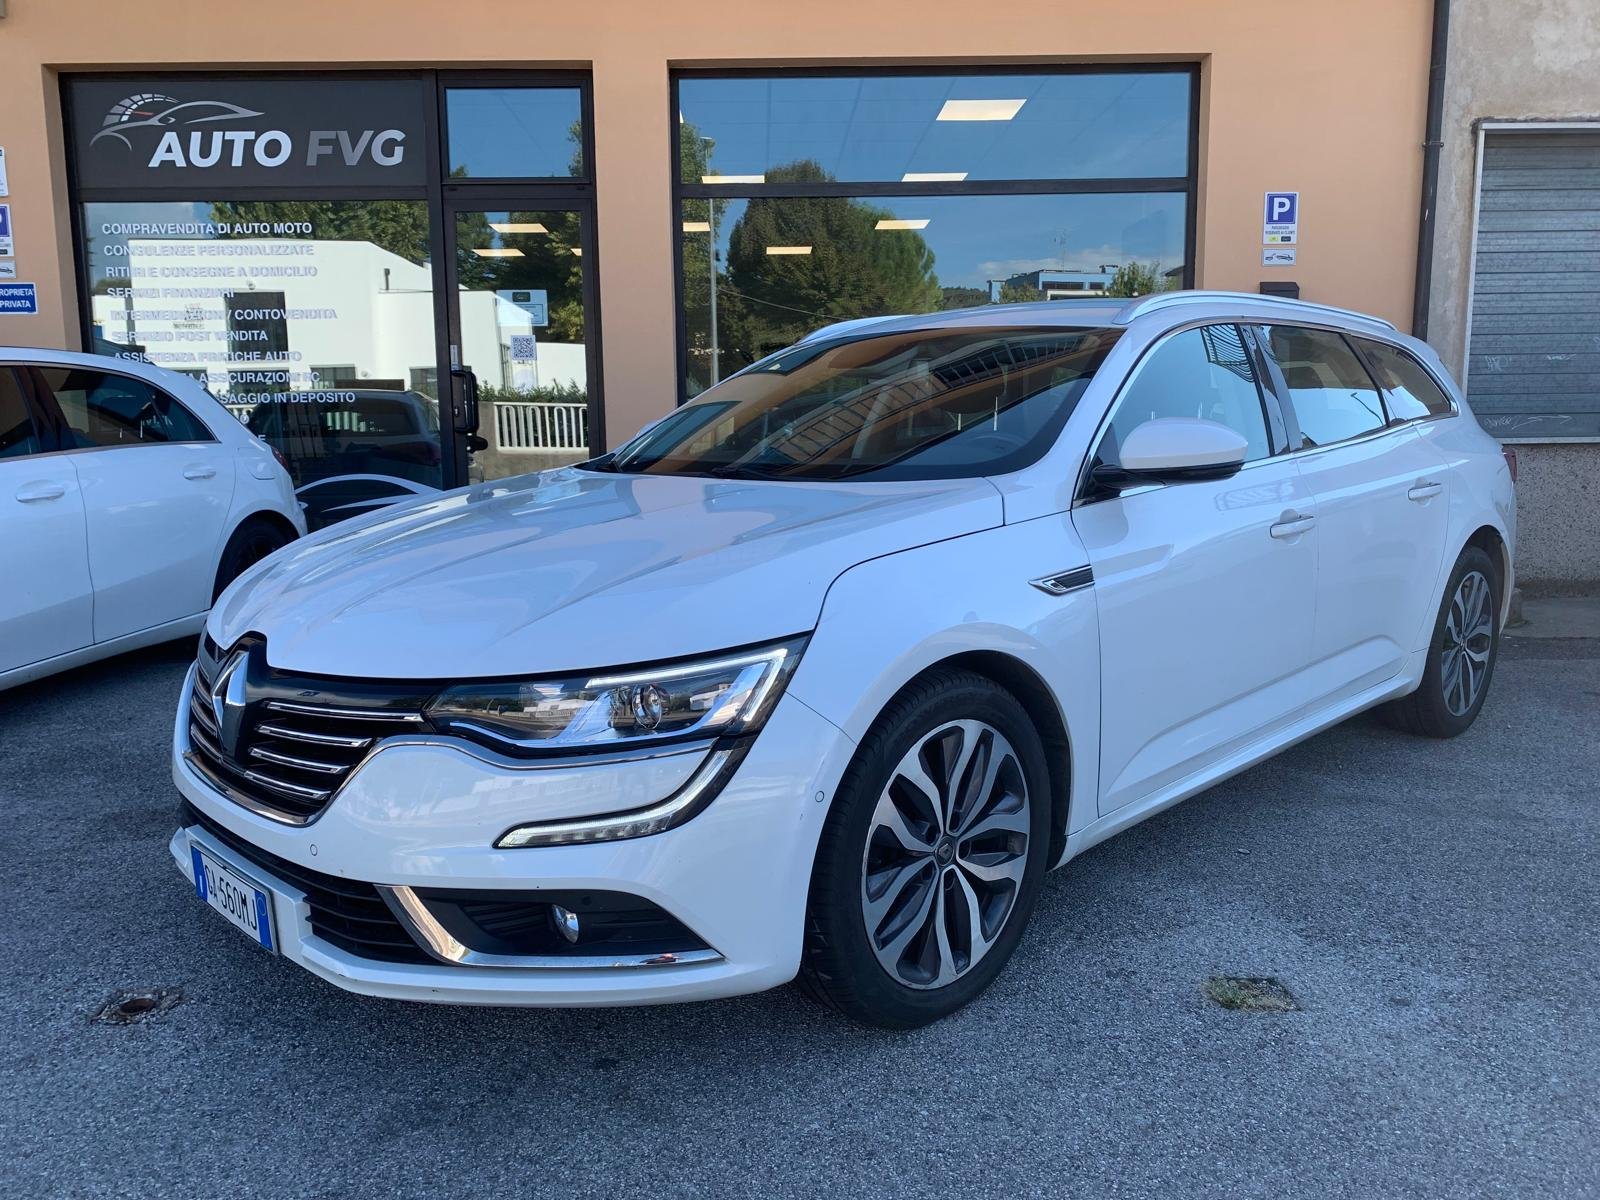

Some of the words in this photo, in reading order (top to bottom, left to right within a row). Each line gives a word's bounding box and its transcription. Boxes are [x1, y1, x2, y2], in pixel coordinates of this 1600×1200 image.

[148, 130, 292, 168] AUTO
[306, 129, 406, 167] FVG
[1273, 197, 1291, 221] P
[102, 223, 215, 235] COMPRAVENDITA
[218, 223, 231, 234] DI
[234, 222, 270, 234] AUTO
[274, 222, 312, 234] MOTO
[104, 245, 196, 256] CONSULENZE
[198, 245, 315, 256] PERSONALIZZATE
[106, 266, 146, 278] RITIRI
[149, 267, 159, 278] E
[162, 266, 234, 278] CONSEGNE
[237, 266, 248, 277] A
[250, 266, 318, 277] DOMICILIO
[0, 288, 34, 297] ROPRIETA'
[0, 300, 31, 308] PRIVATA
[235, 309, 338, 320] CONTOVENDITA
[176, 331, 210, 342] POST
[214, 331, 268, 341] VENDITA
[265, 351, 302, 362] AUTO
[219, 393, 271, 404] SAGGIO
[274, 393, 287, 403] IN
[290, 392, 356, 403] DEPOSITO
